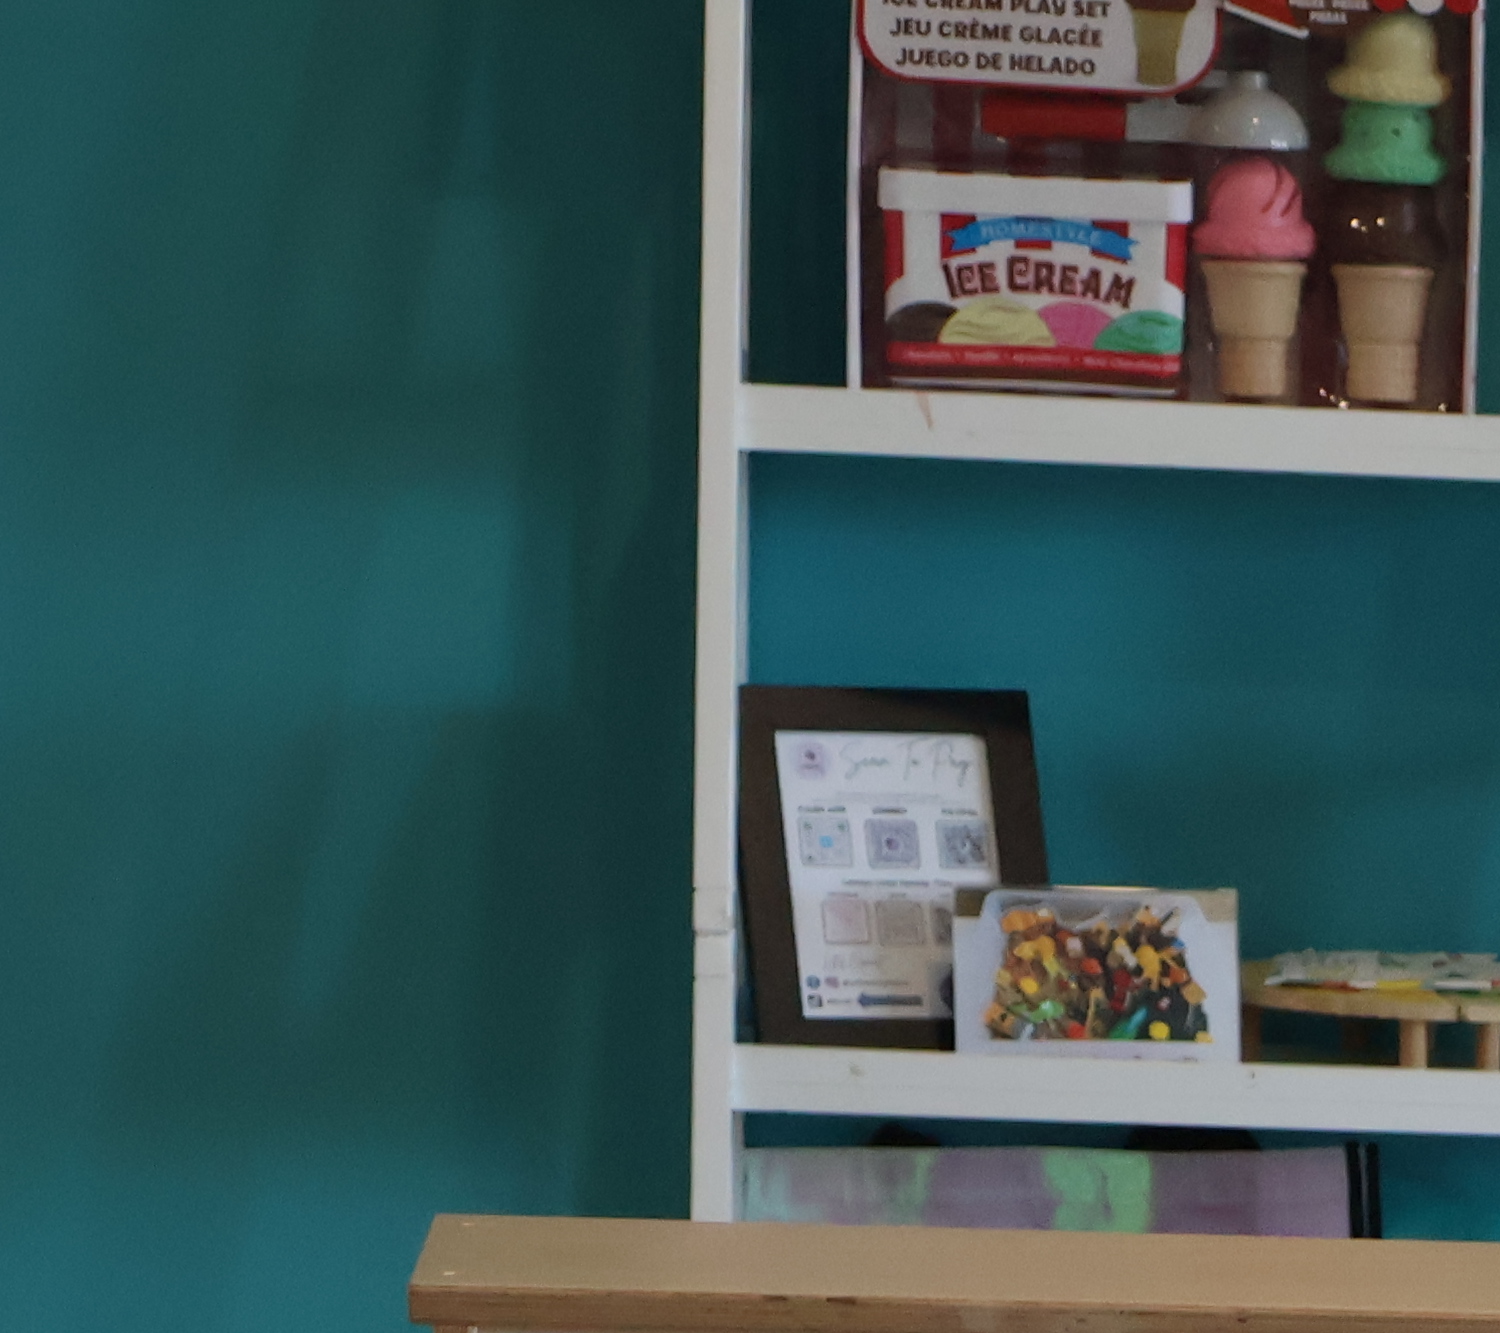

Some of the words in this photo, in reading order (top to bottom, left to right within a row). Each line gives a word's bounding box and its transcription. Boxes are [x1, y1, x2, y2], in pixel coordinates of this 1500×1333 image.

[1074, 0, 1111, 18] SET
[890, 18, 931, 37] JEU
[938, 18, 1012, 42] CRÈME
[1019, 24, 1103, 48] GLACÉE
[896, 48, 970, 67] JUEGO
[976, 52, 1002, 70] DE
[1009, 54, 1096, 75] HELADO
[942, 262, 999, 297] ICE
[1008, 256, 1135, 308] CREAM
